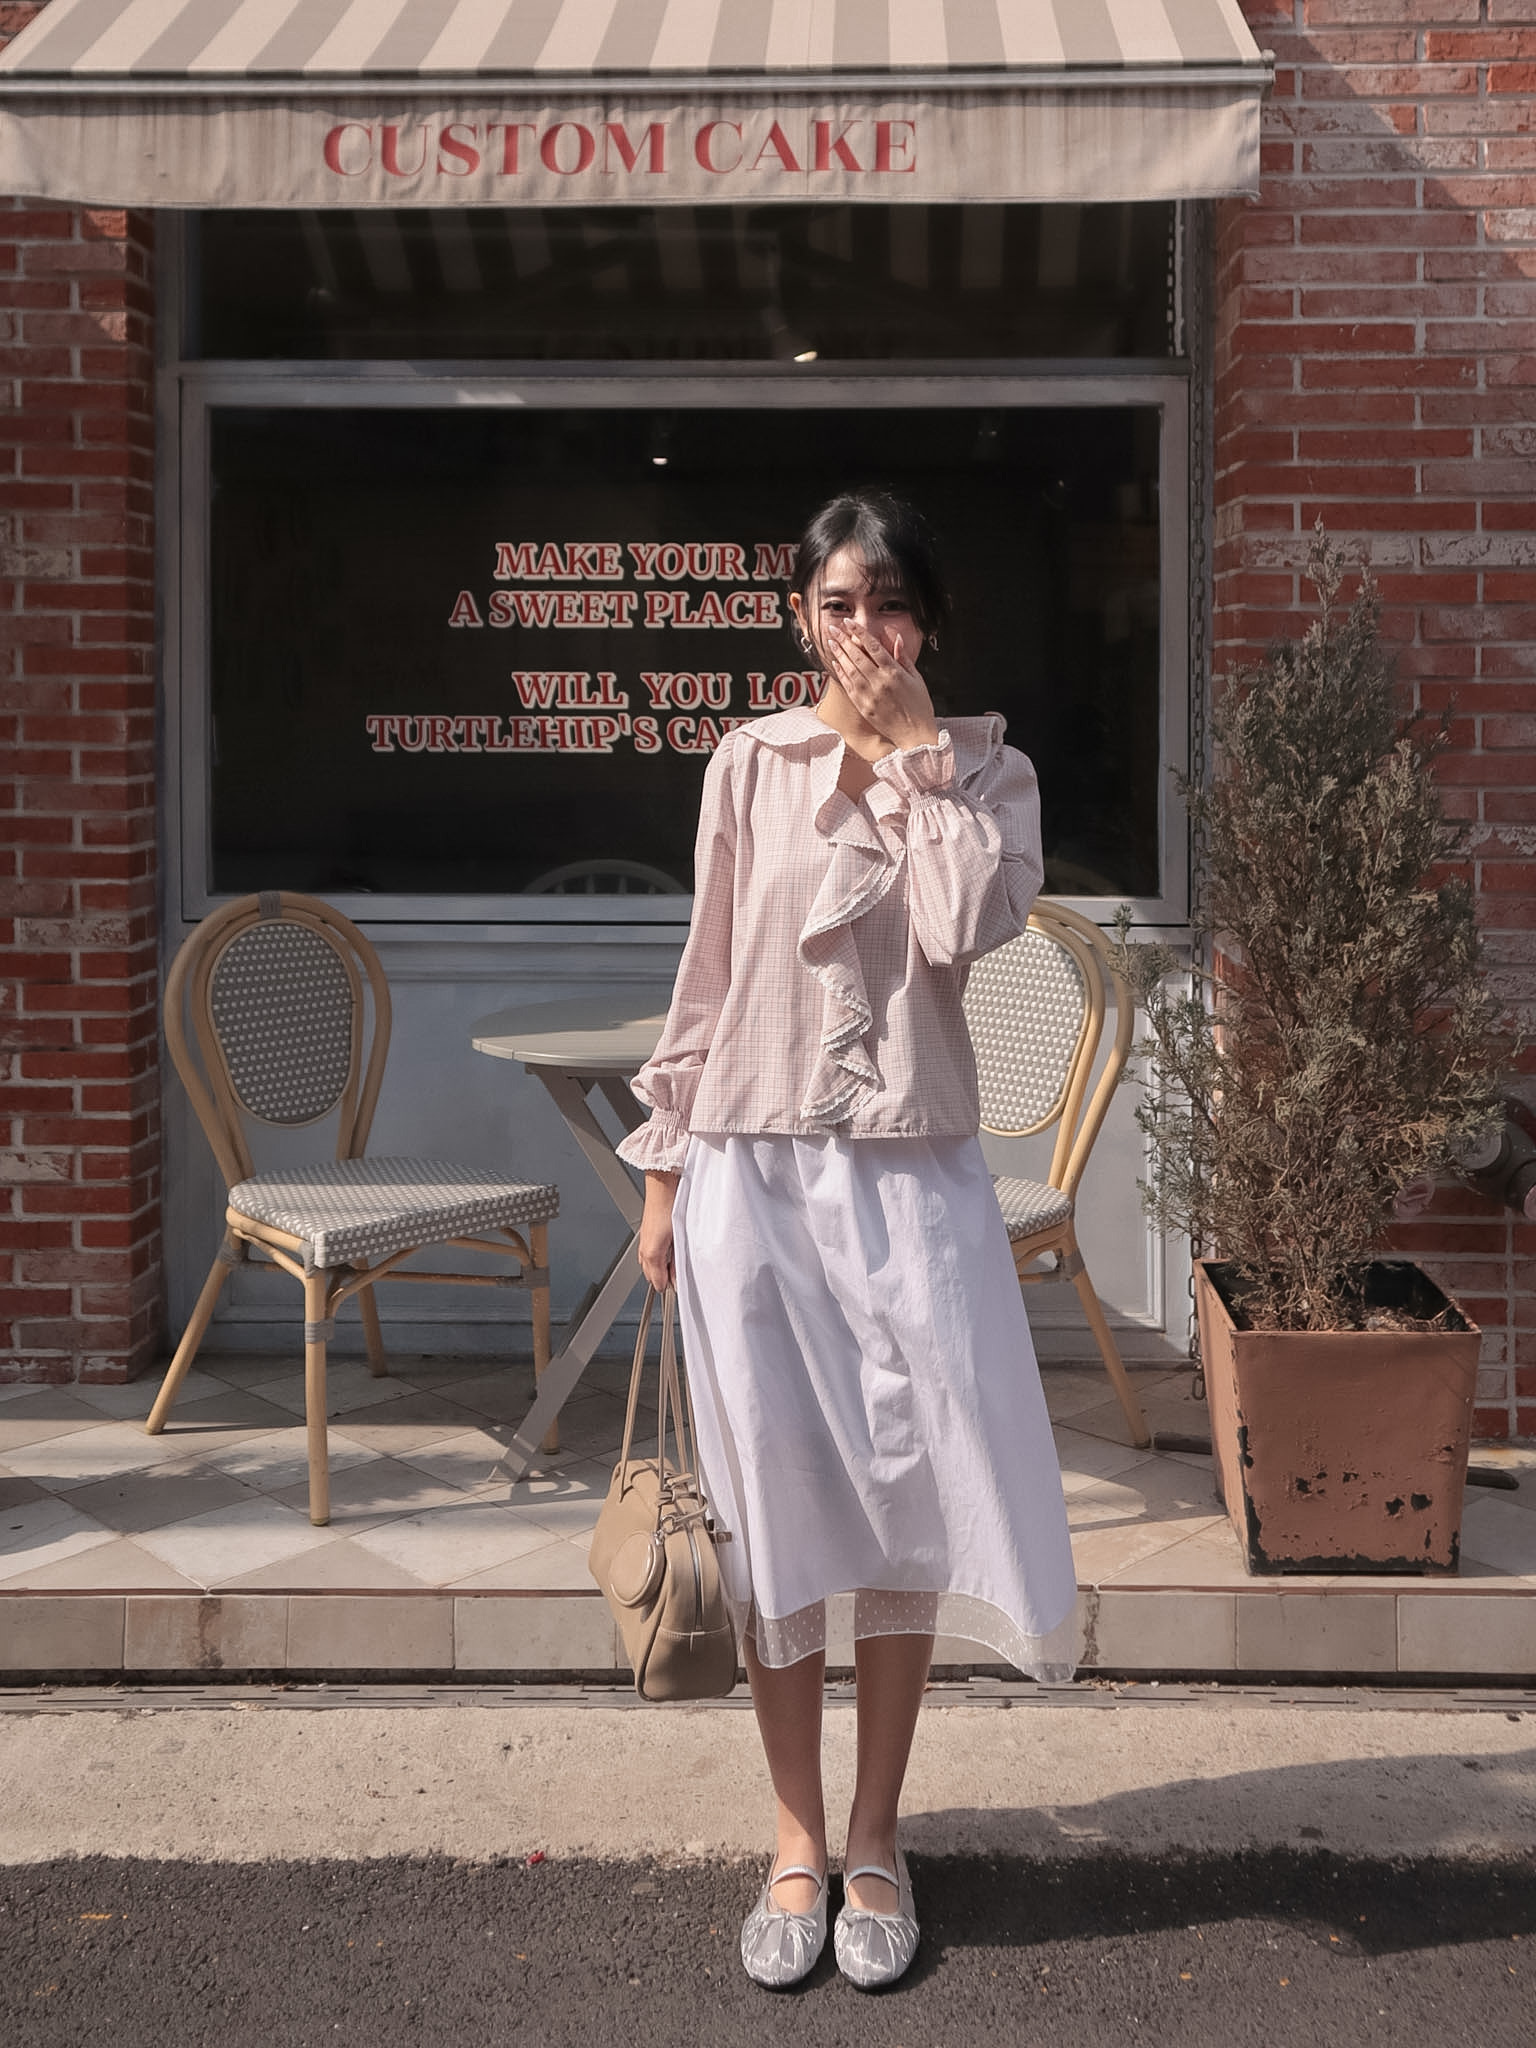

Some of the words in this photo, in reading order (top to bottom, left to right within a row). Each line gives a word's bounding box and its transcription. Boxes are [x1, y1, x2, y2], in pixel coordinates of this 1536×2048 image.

[323, 121, 668, 177] CUSTOM
[694, 118, 917, 174] CAKE
[493, 543, 623, 580] MAKE
[627, 543, 749, 580] YOUR
[752, 543, 800, 580] M
[448, 591, 484, 628] A
[488, 591, 638, 628] SWEET
[643, 591, 783, 629] PLACE
[511, 672, 629, 709] WILL
[640, 672, 732, 710] YOU
[747, 671, 830, 710] LOV
[366, 713, 663, 753] TURTLEHIP'S
[666, 716, 757, 754] CA
